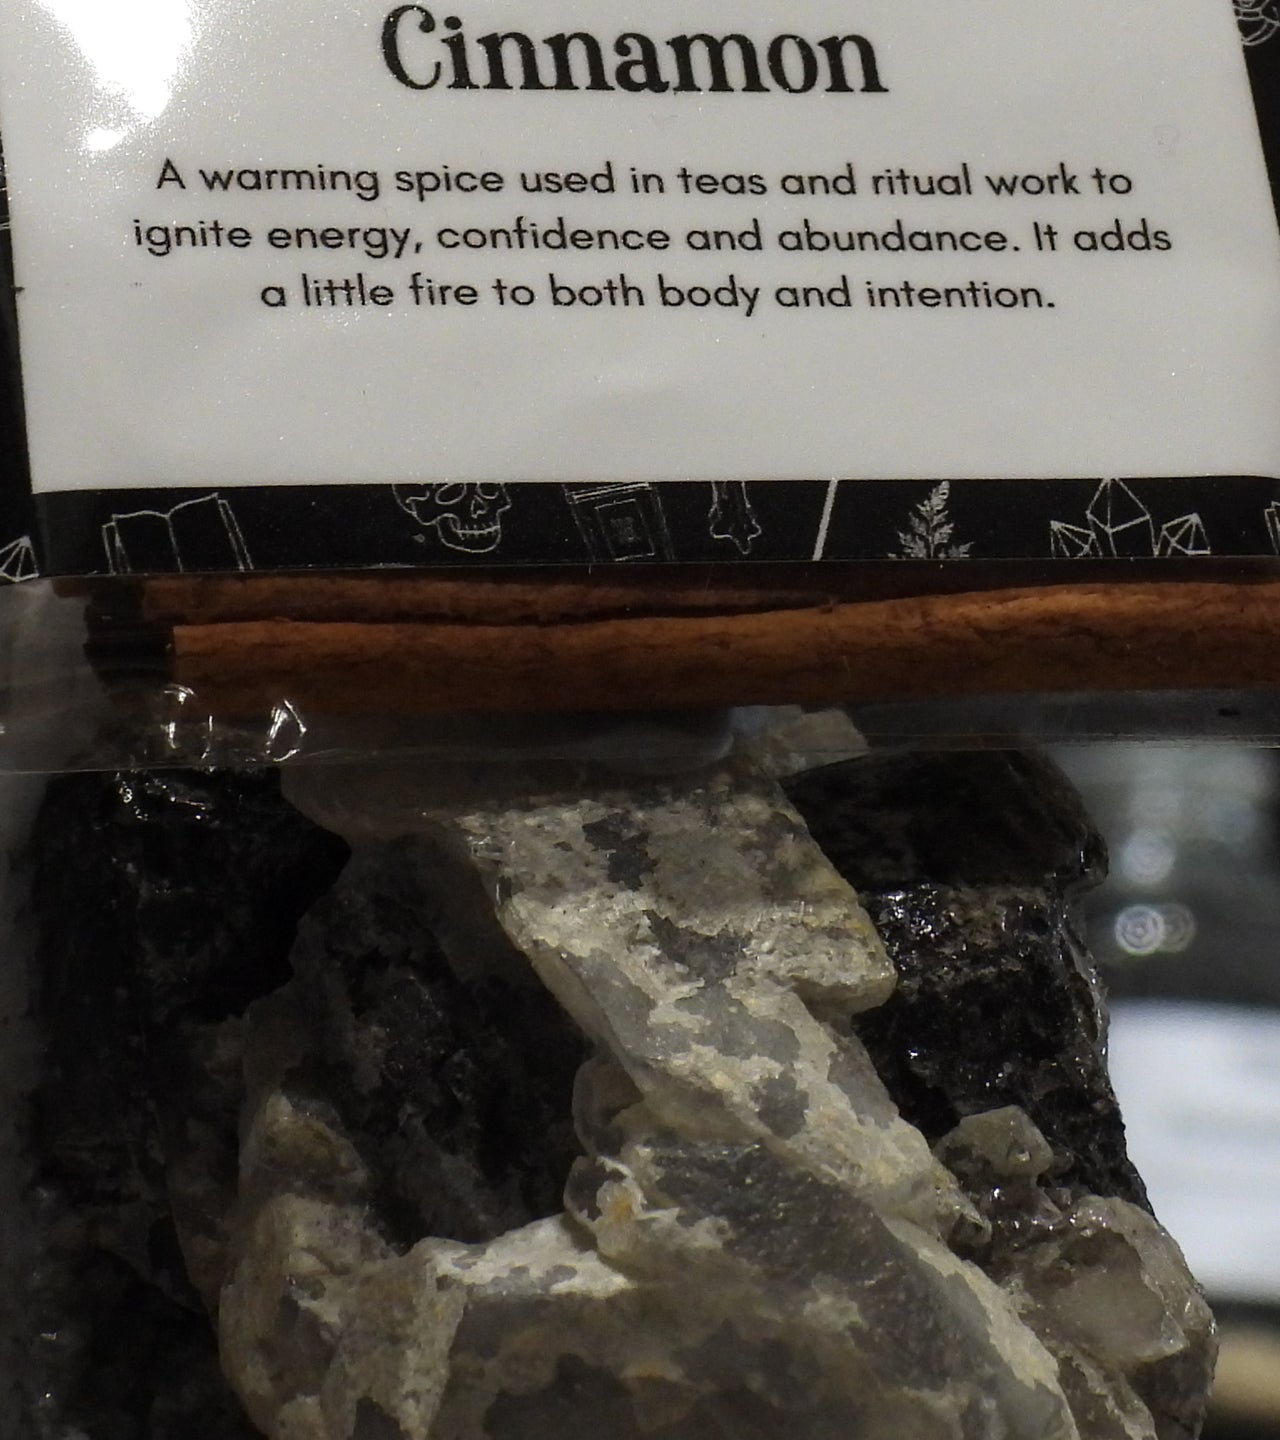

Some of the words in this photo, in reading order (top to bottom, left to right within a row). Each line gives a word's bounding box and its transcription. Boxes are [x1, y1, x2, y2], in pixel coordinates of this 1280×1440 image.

[379, 4, 890, 95] Cinnamon
[156, 157, 187, 191] A
[198, 163, 381, 203] warming
[394, 164, 505, 203] spice
[519, 160, 616, 195] used
[629, 166, 665, 195] in
[676, 167, 768, 196] teas
[780, 162, 857, 197] and
[871, 162, 973, 197] ritual
[984, 161, 1081, 197] work
[1091, 167, 1133, 196] to
[133, 218, 253, 258] ignite
[267, 227, 423, 261] energy,
[436, 216, 671, 252] confidence
[685, 217, 764, 253] and
[777, 217, 1020, 254] abundance.
[1032, 221, 1058, 253] It
[1073, 217, 1173, 253] adds
[260, 284, 287, 308] a
[301, 272, 395, 308] little
[408, 271, 480, 307] fire
[491, 278, 536, 308] to
[548, 272, 645, 308] both
[657, 272, 761, 318] body
[774, 274, 853, 309] and
[865, 279, 1056, 309] intention.
